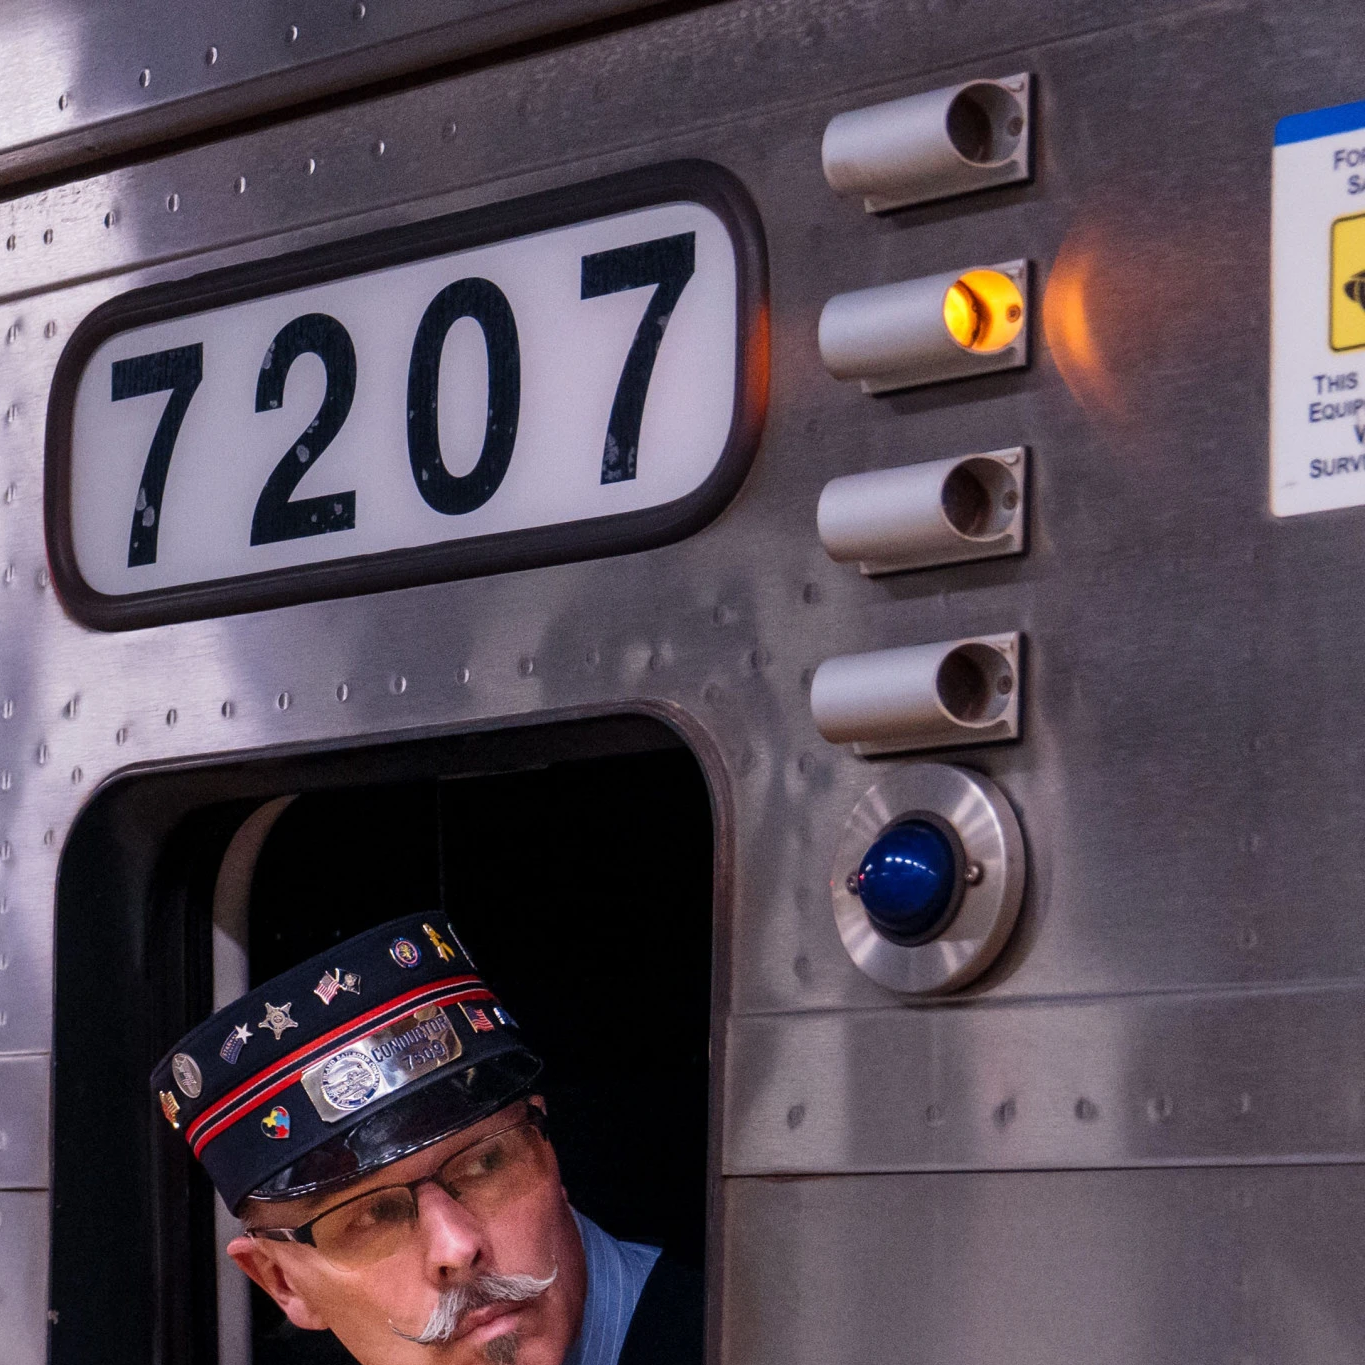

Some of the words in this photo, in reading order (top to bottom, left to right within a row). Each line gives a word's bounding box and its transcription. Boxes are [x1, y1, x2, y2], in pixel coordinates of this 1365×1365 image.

[111, 230, 696, 568] 7207
[1313, 372, 1358, 395] THIS
[371, 1015, 449, 1062] CONDUCTOR
[403, 1039, 446, 1070] 7509
